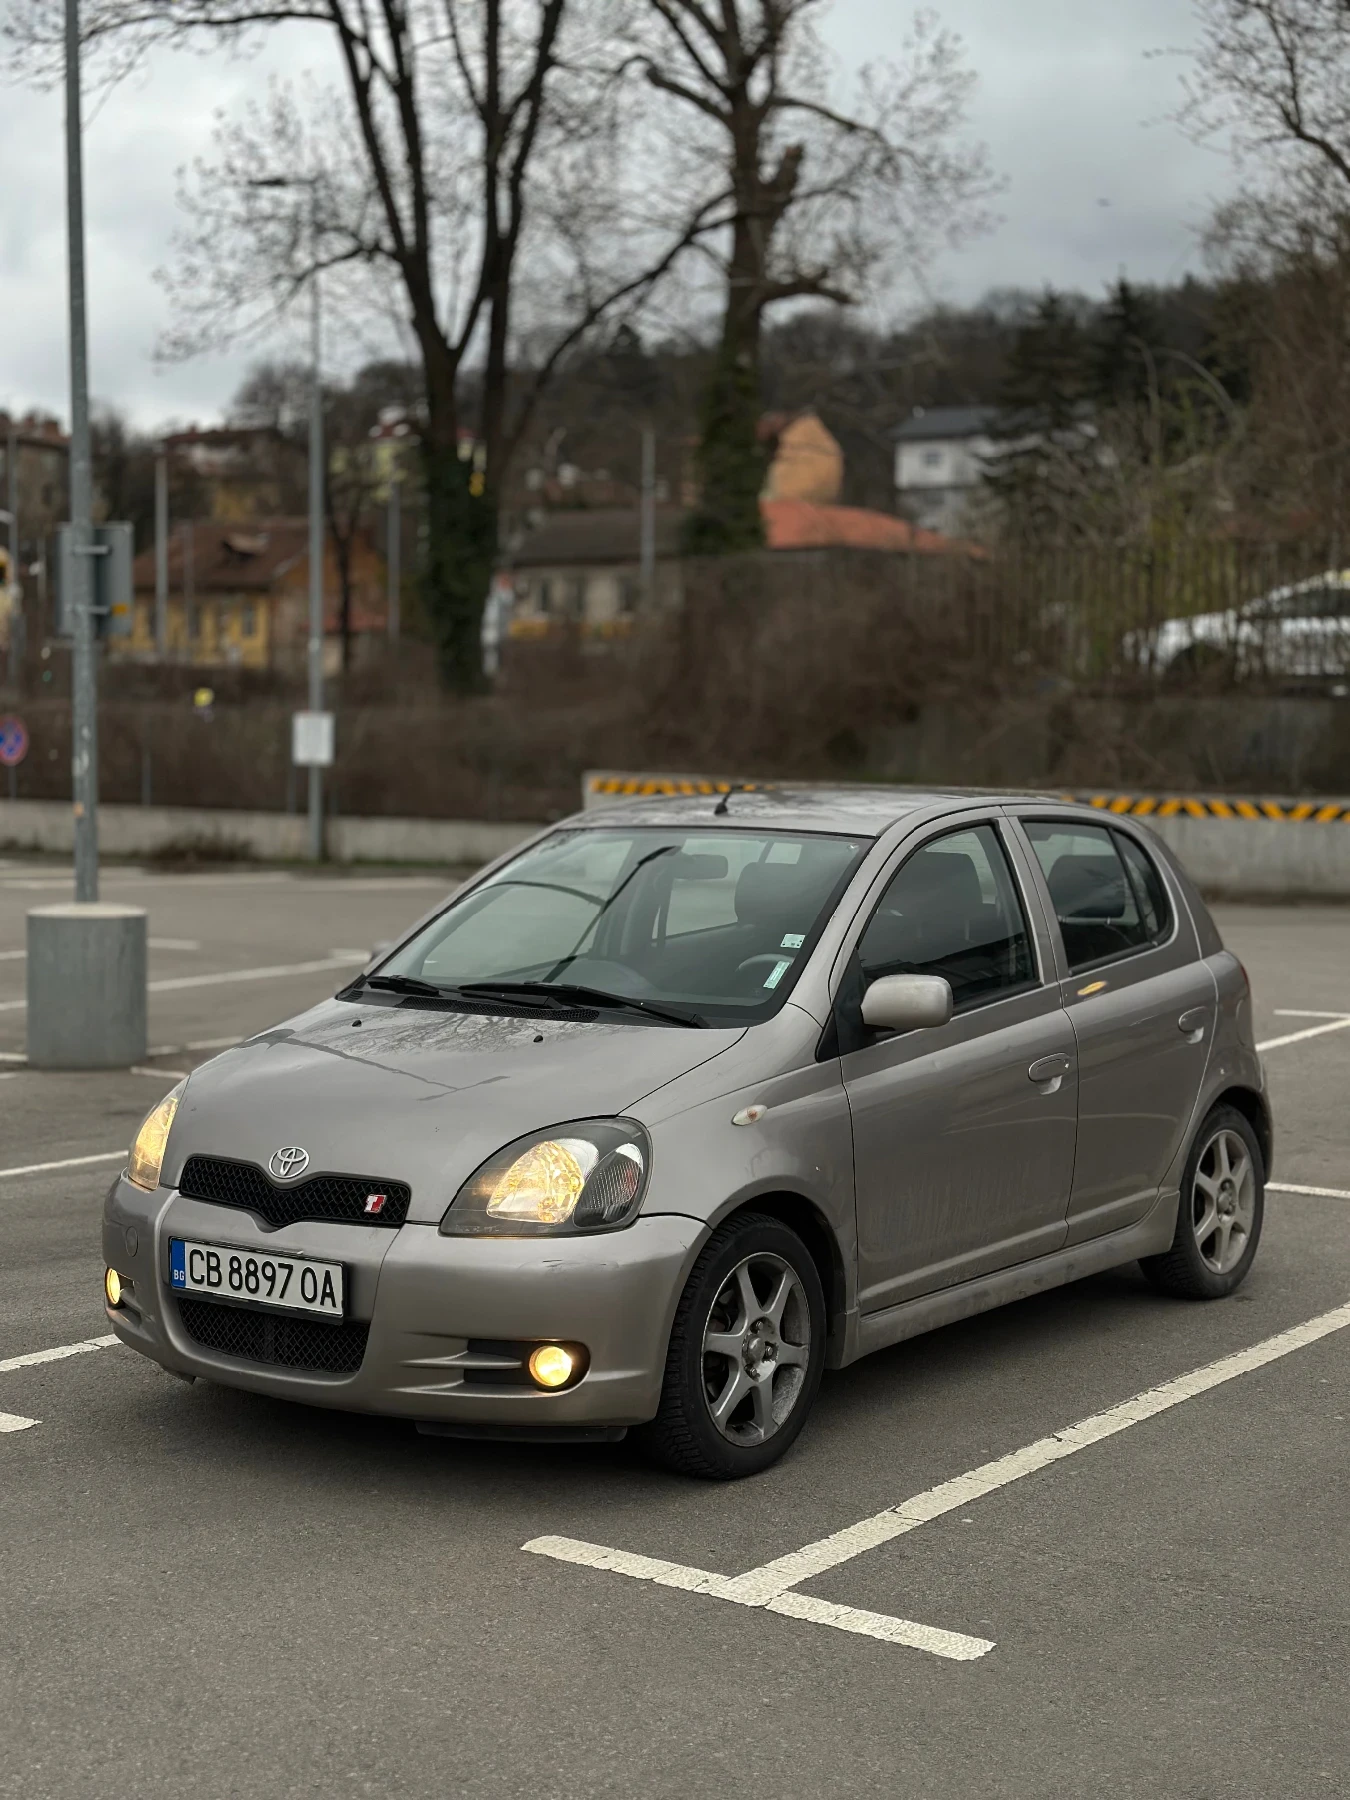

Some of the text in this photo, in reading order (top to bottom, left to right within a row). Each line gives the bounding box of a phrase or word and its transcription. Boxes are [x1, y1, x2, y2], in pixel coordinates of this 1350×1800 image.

[173, 1269, 185, 1281] BG
[190, 1249, 337, 1308] CB 8897 OA
